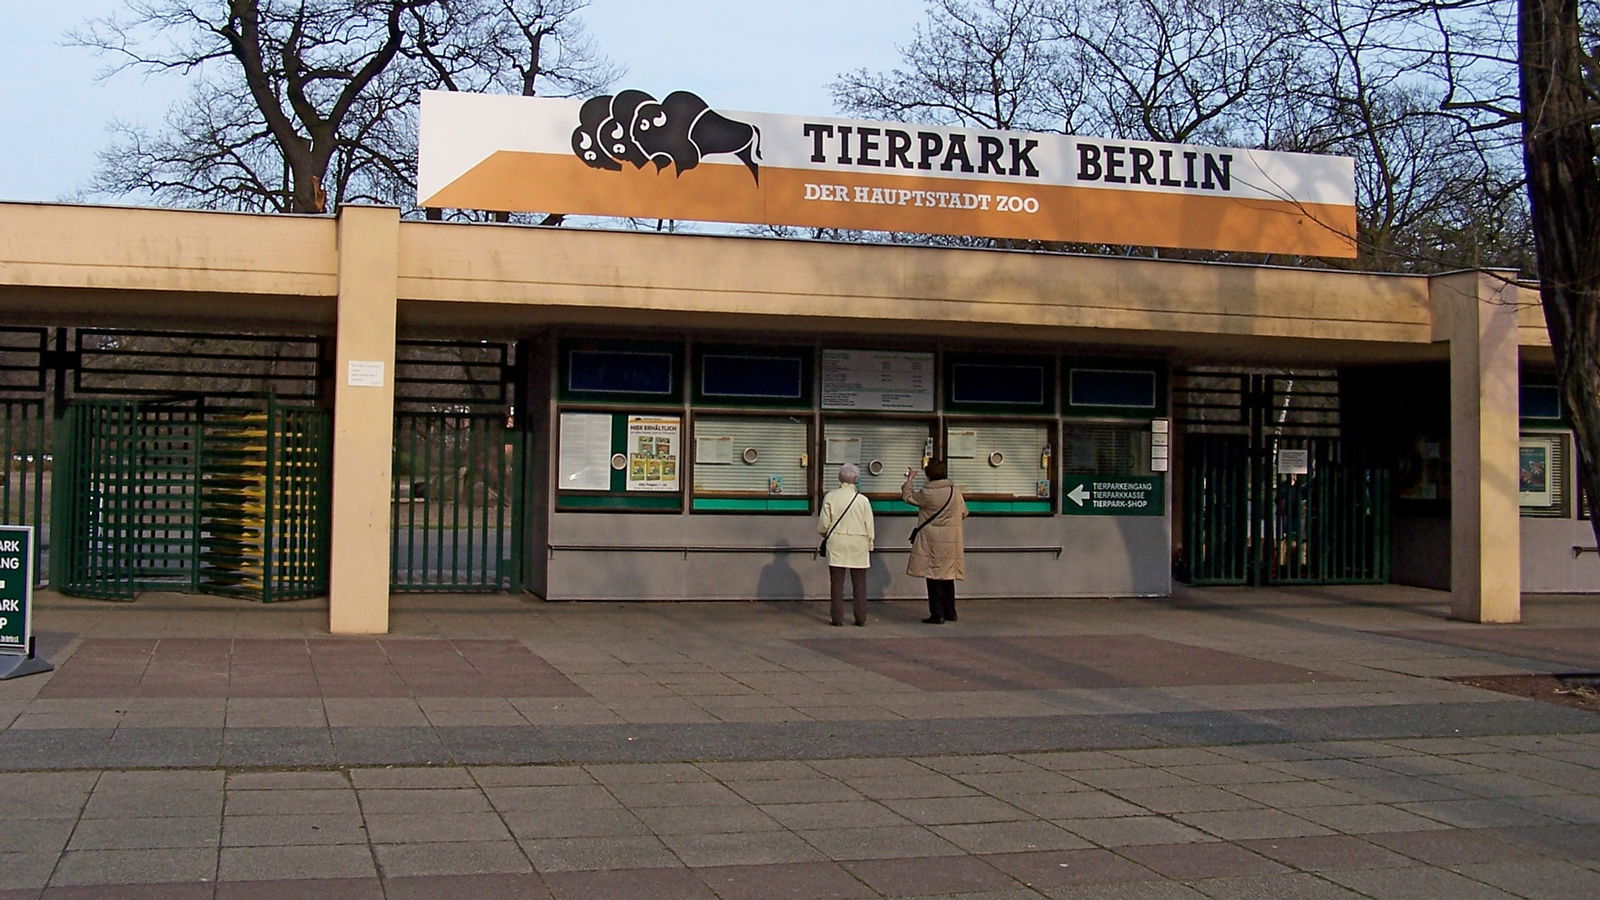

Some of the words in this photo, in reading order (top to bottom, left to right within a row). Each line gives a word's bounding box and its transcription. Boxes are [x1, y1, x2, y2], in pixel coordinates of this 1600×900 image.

[803, 122, 1040, 178] TIERPARK
[1076, 143, 1234, 191] BERLIN
[804, 184, 848, 202] DER
[854, 186, 992, 213] HAUPTSTADT
[996, 195, 1040, 213] ZOO
[1093, 491, 1145, 499] TIERPARKKASSE
[1093, 500, 1147, 508] TIERPARK-SHOP
[0, 557, 20, 570] NG
